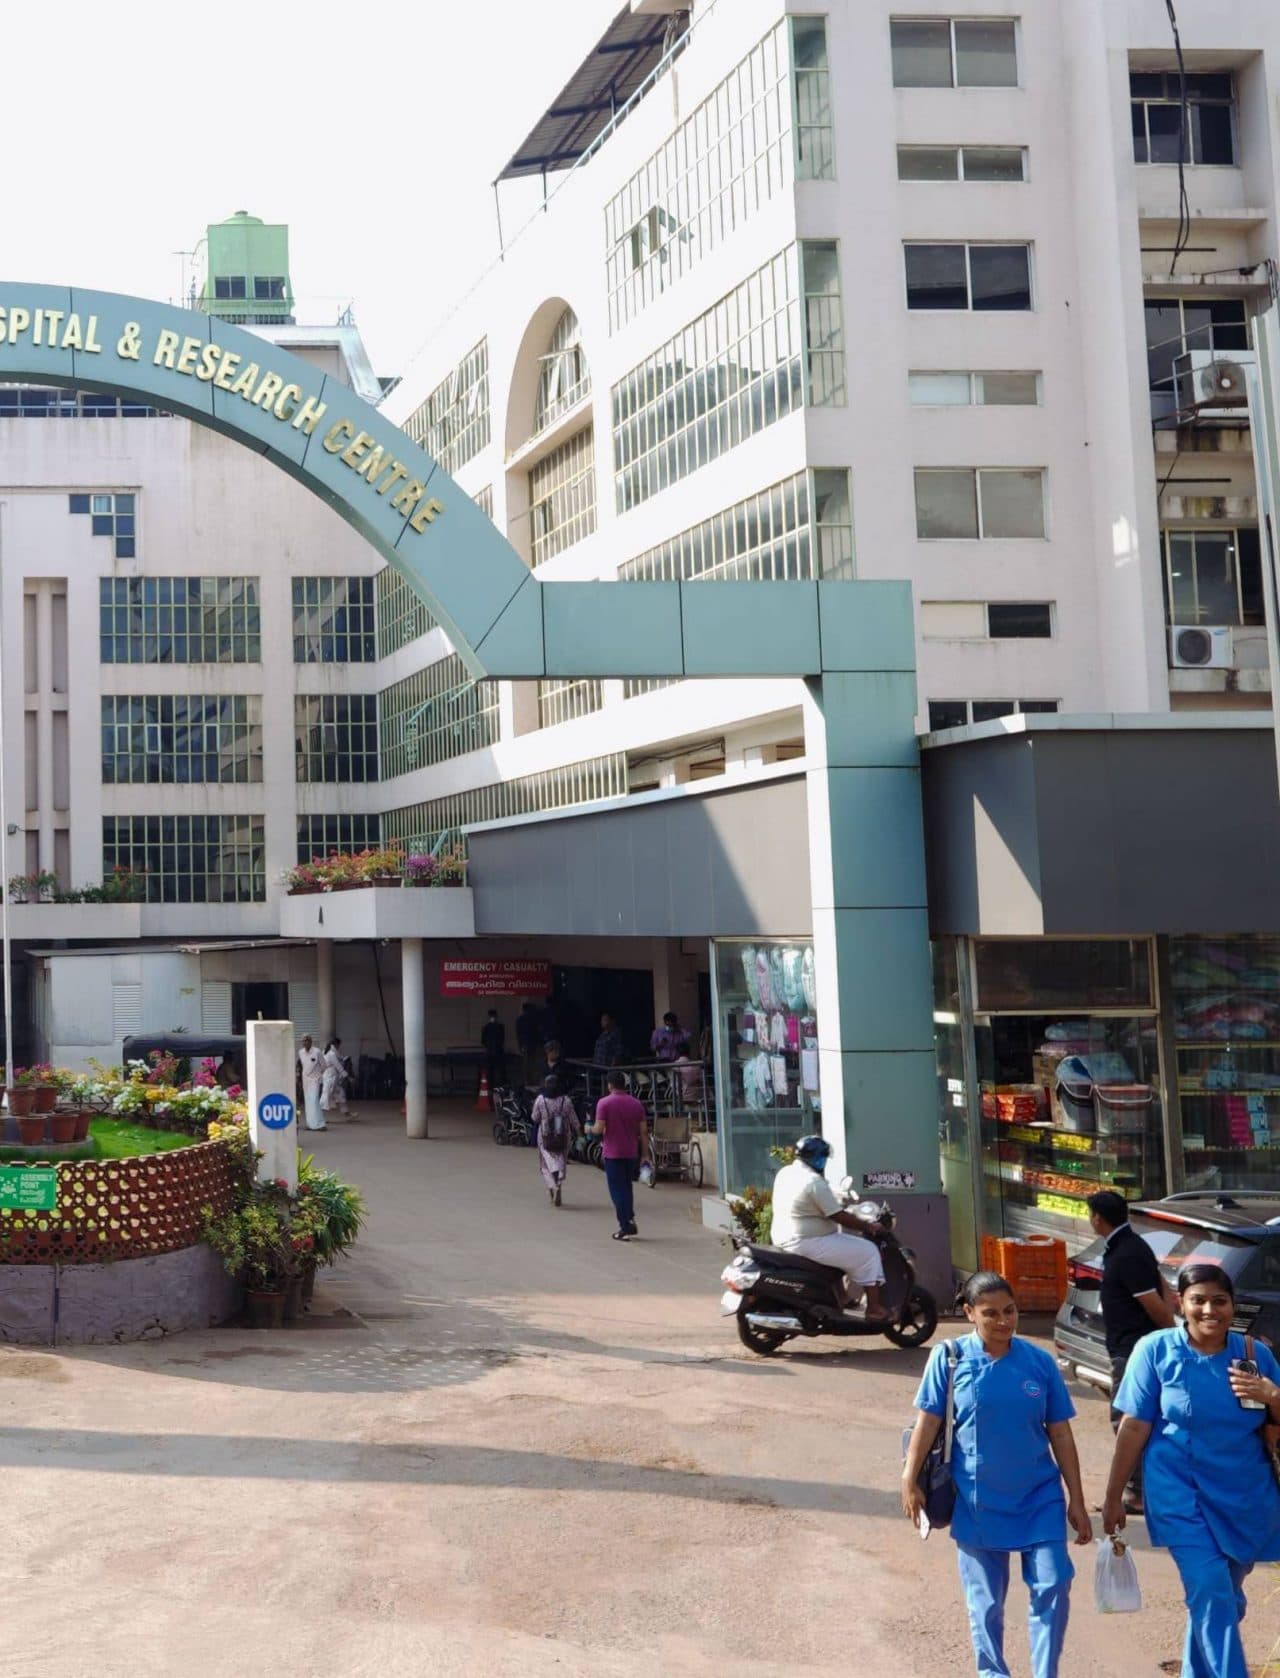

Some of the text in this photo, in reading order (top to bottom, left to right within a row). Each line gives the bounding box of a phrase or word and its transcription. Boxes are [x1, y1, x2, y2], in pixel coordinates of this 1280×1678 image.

[117, 321, 143, 360] &
[153, 329, 327, 436] RESEARCH
[322, 418, 445, 535] CENTRE
[444, 962, 497, 971] EMERGENCY
[504, 962, 548, 971] CASUALTY
[263, 1105, 291, 1121] OUT
